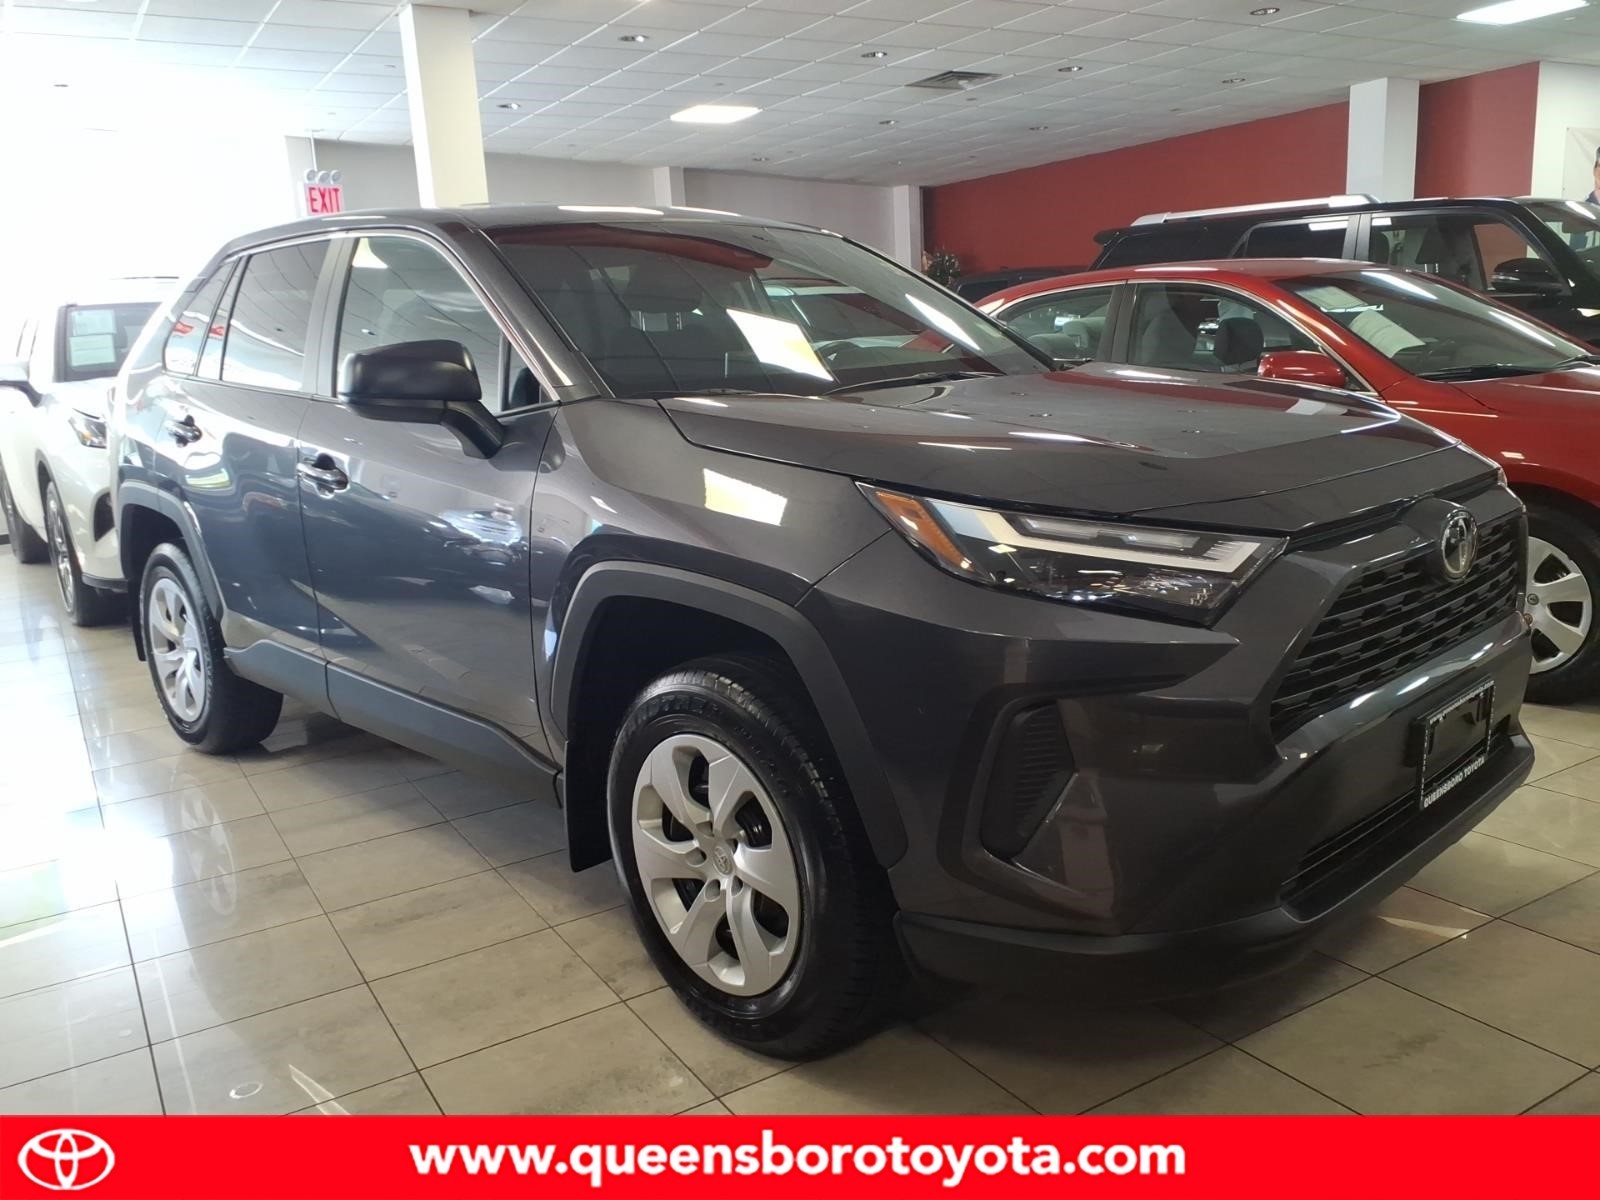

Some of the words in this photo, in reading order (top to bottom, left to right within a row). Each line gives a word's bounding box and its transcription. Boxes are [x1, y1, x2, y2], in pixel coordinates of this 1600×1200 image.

[308, 186, 341, 213] EXIT
[1424, 772, 1463, 808] QUEENSBORO
[1463, 756, 1485, 778] TOYOTA
